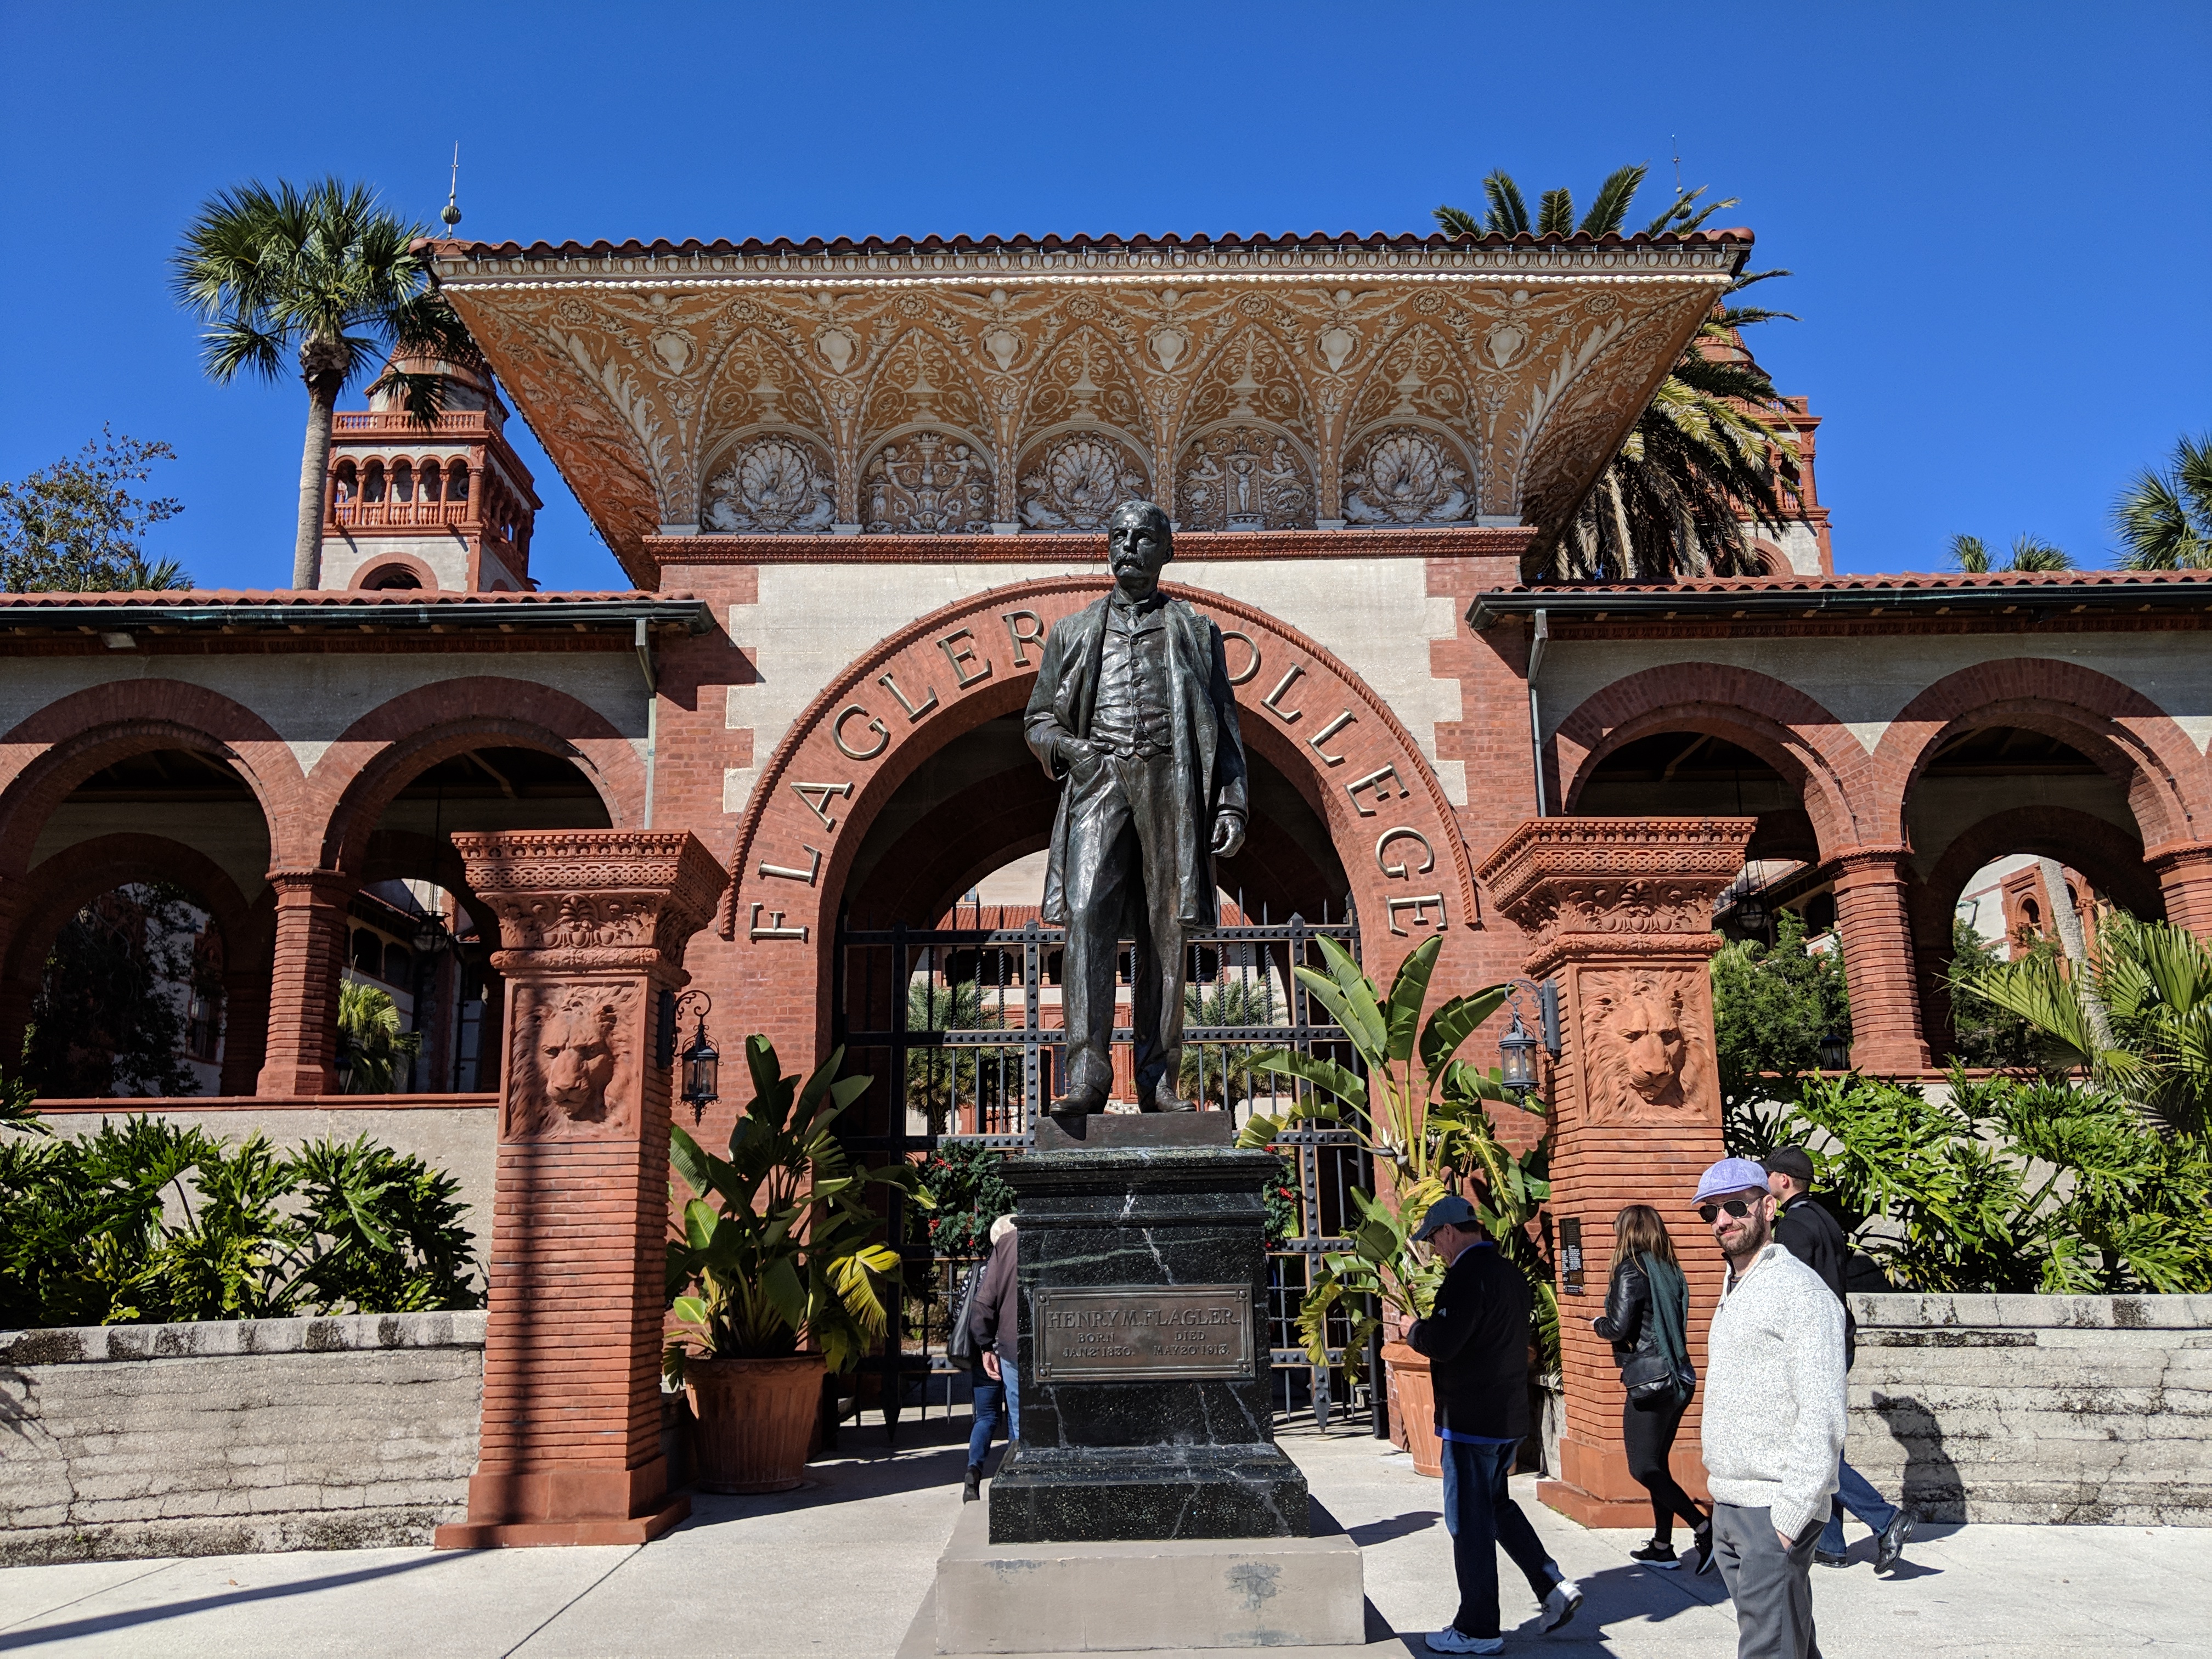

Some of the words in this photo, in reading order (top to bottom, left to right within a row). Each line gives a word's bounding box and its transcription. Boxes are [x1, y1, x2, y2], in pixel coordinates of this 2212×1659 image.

[749, 610, 1045, 941] FLAGLER
[1221, 631, 1447, 936] OLLEGE
[1047, 1310, 1119, 1328] HENRY
[1077, 1332, 1115, 1343] BORN
[1174, 1330, 1206, 1341] DIED
[1154, 1345, 1180, 1356] MAY
